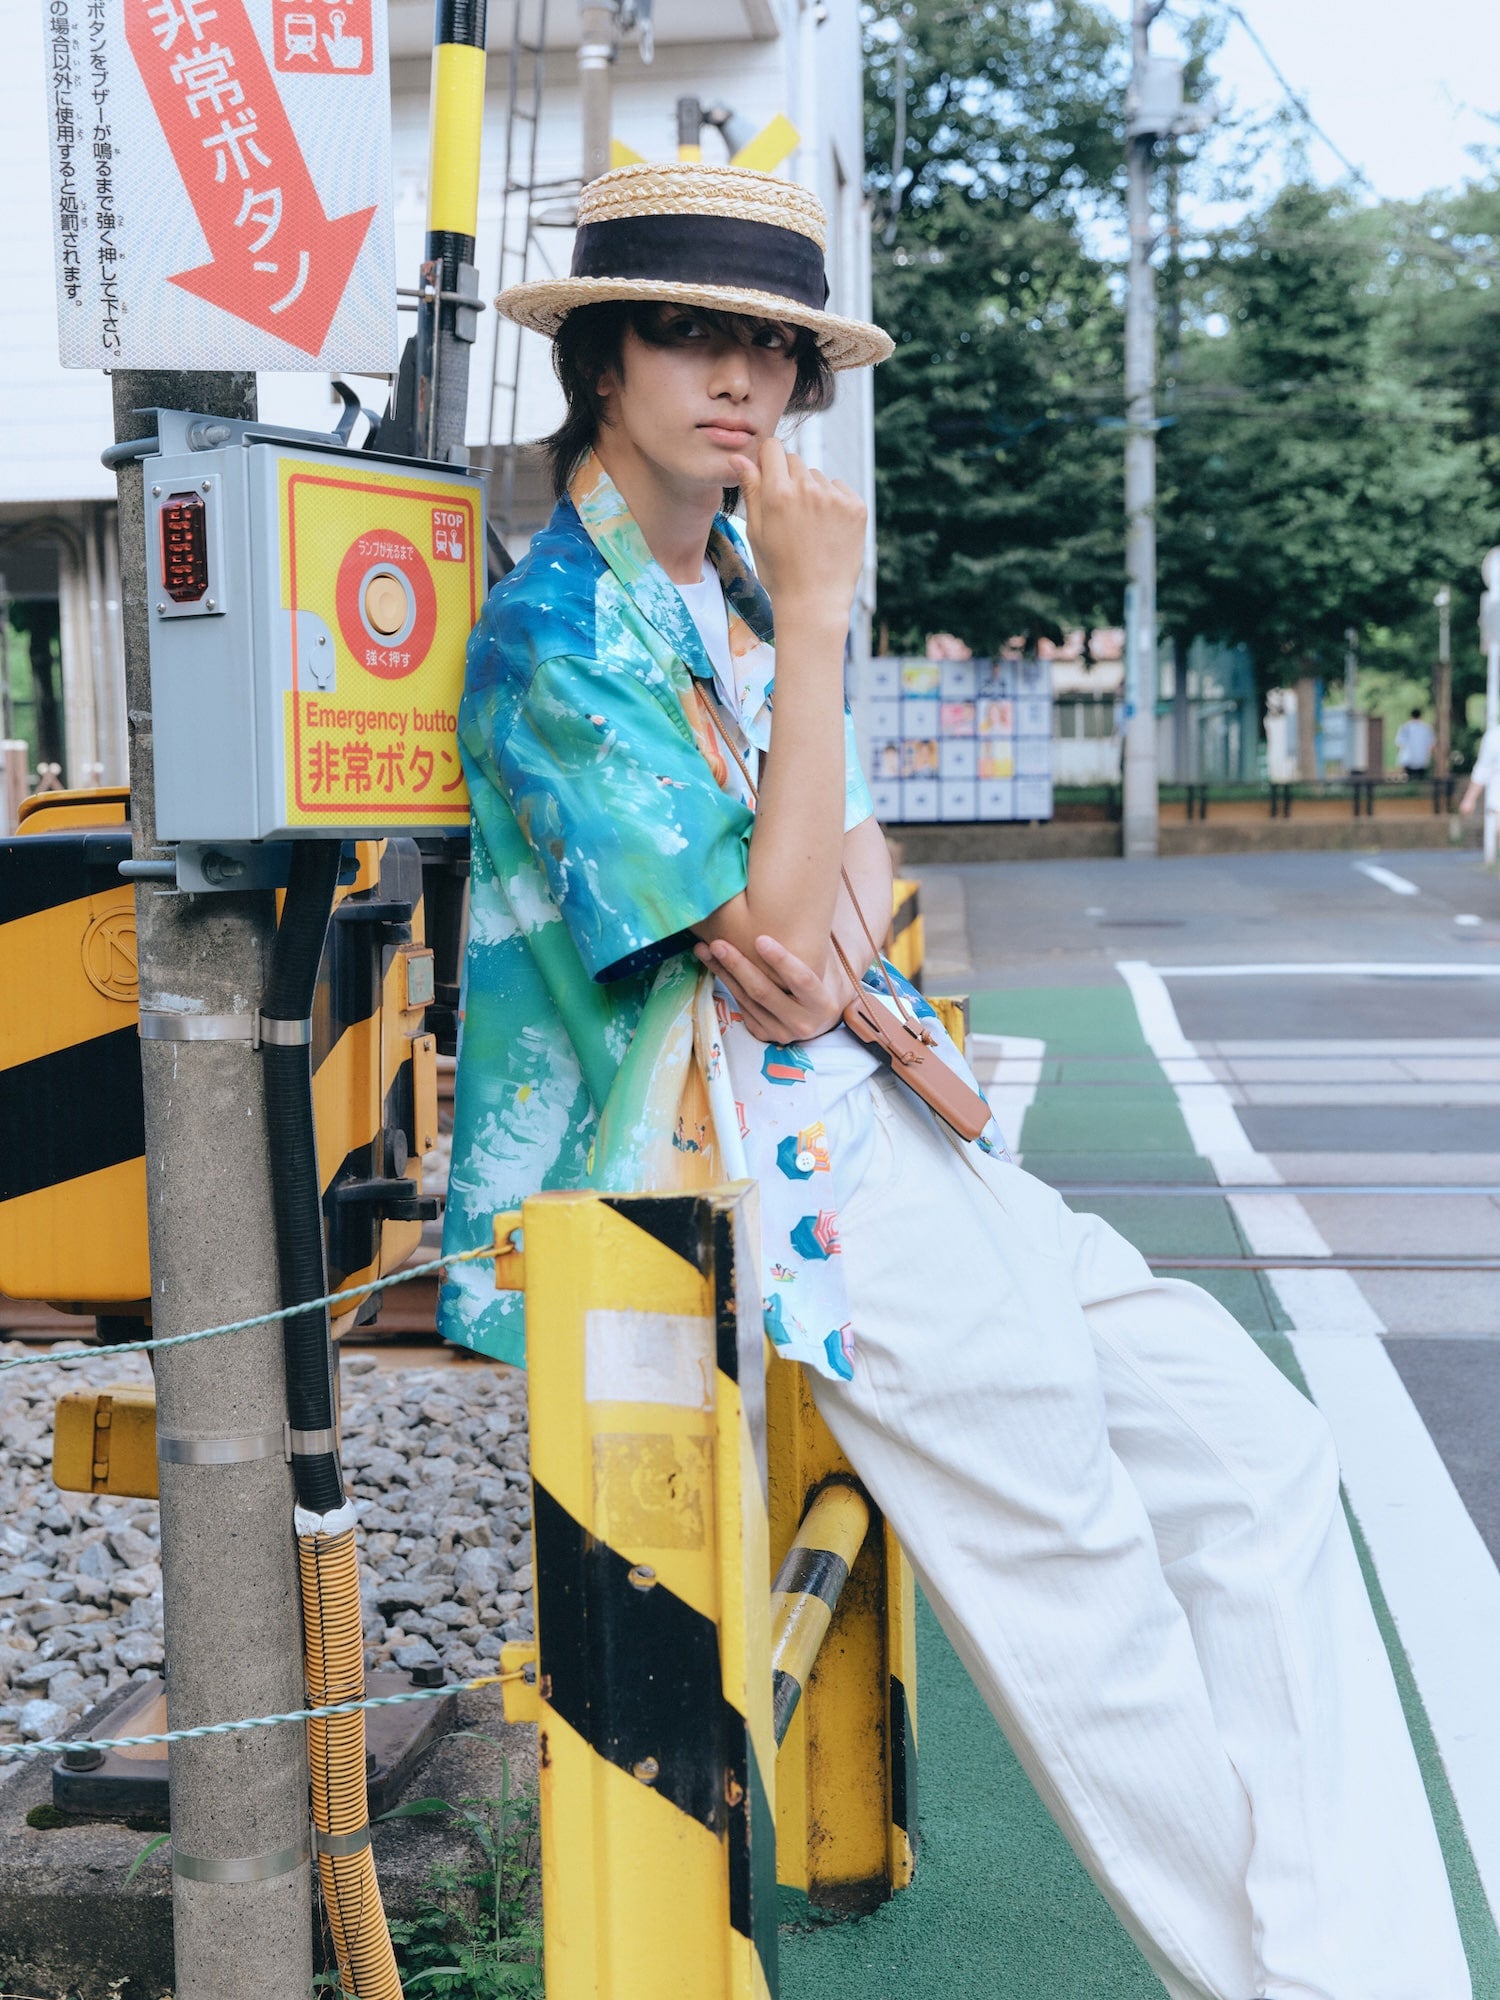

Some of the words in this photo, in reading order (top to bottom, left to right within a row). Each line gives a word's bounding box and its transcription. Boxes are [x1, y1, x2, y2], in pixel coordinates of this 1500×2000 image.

[50, 1, 83, 307] の場合以外に使用すると処罰されます。
[142, 0, 311, 316] 非常ボタン
[87, 0, 121, 357] ボタンをブザーが鳴るまで強く押して下さい。
[433, 511, 464, 528] STOP
[357, 539, 415, 561] ランプが光るまで
[365, 649, 412, 668] 強く押す
[306, 701, 408, 736] Emergency
[413, 706, 458, 733] butto
[308, 740, 465, 795] 非常ボタン
